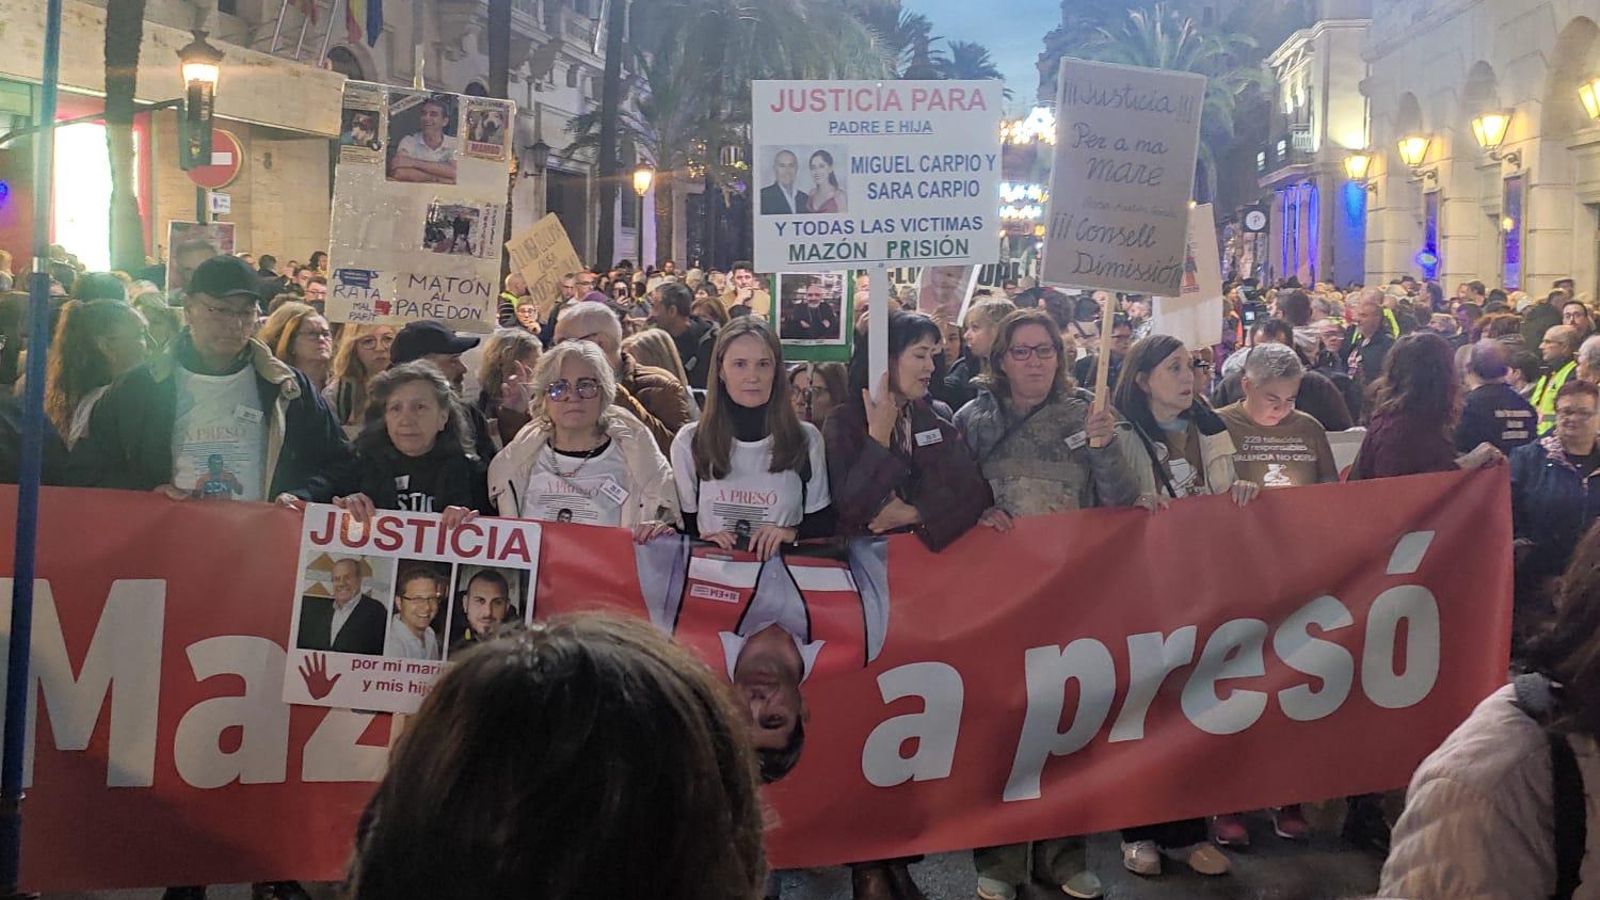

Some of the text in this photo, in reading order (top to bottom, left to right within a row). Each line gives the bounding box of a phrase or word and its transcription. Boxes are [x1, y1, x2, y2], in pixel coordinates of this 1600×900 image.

[770, 87, 987, 113] JUSTICIA PARA
[828, 120, 933, 133] PADRE E HIJA
[1113, 137, 1128, 151] a
[851, 154, 997, 174] MIGUEL CARPIO Y
[867, 180, 980, 200] SARA CARPIO
[775, 215, 983, 236] Y TODAS LAS VICTIMAS
[789, 235, 969, 261] MAZÓN PRISIÓN
[333, 285, 381, 299] RATA
[408, 273, 490, 297] MATÓN
[430, 293, 450, 302] AL
[716, 488, 778, 505] A PRESÓ
[310, 512, 531, 563] JUSTICIA
[0, 530, 1440, 802] Maz a presó
[351, 658, 446, 675] por mi mari
[362, 679, 432, 696] y mis hij
